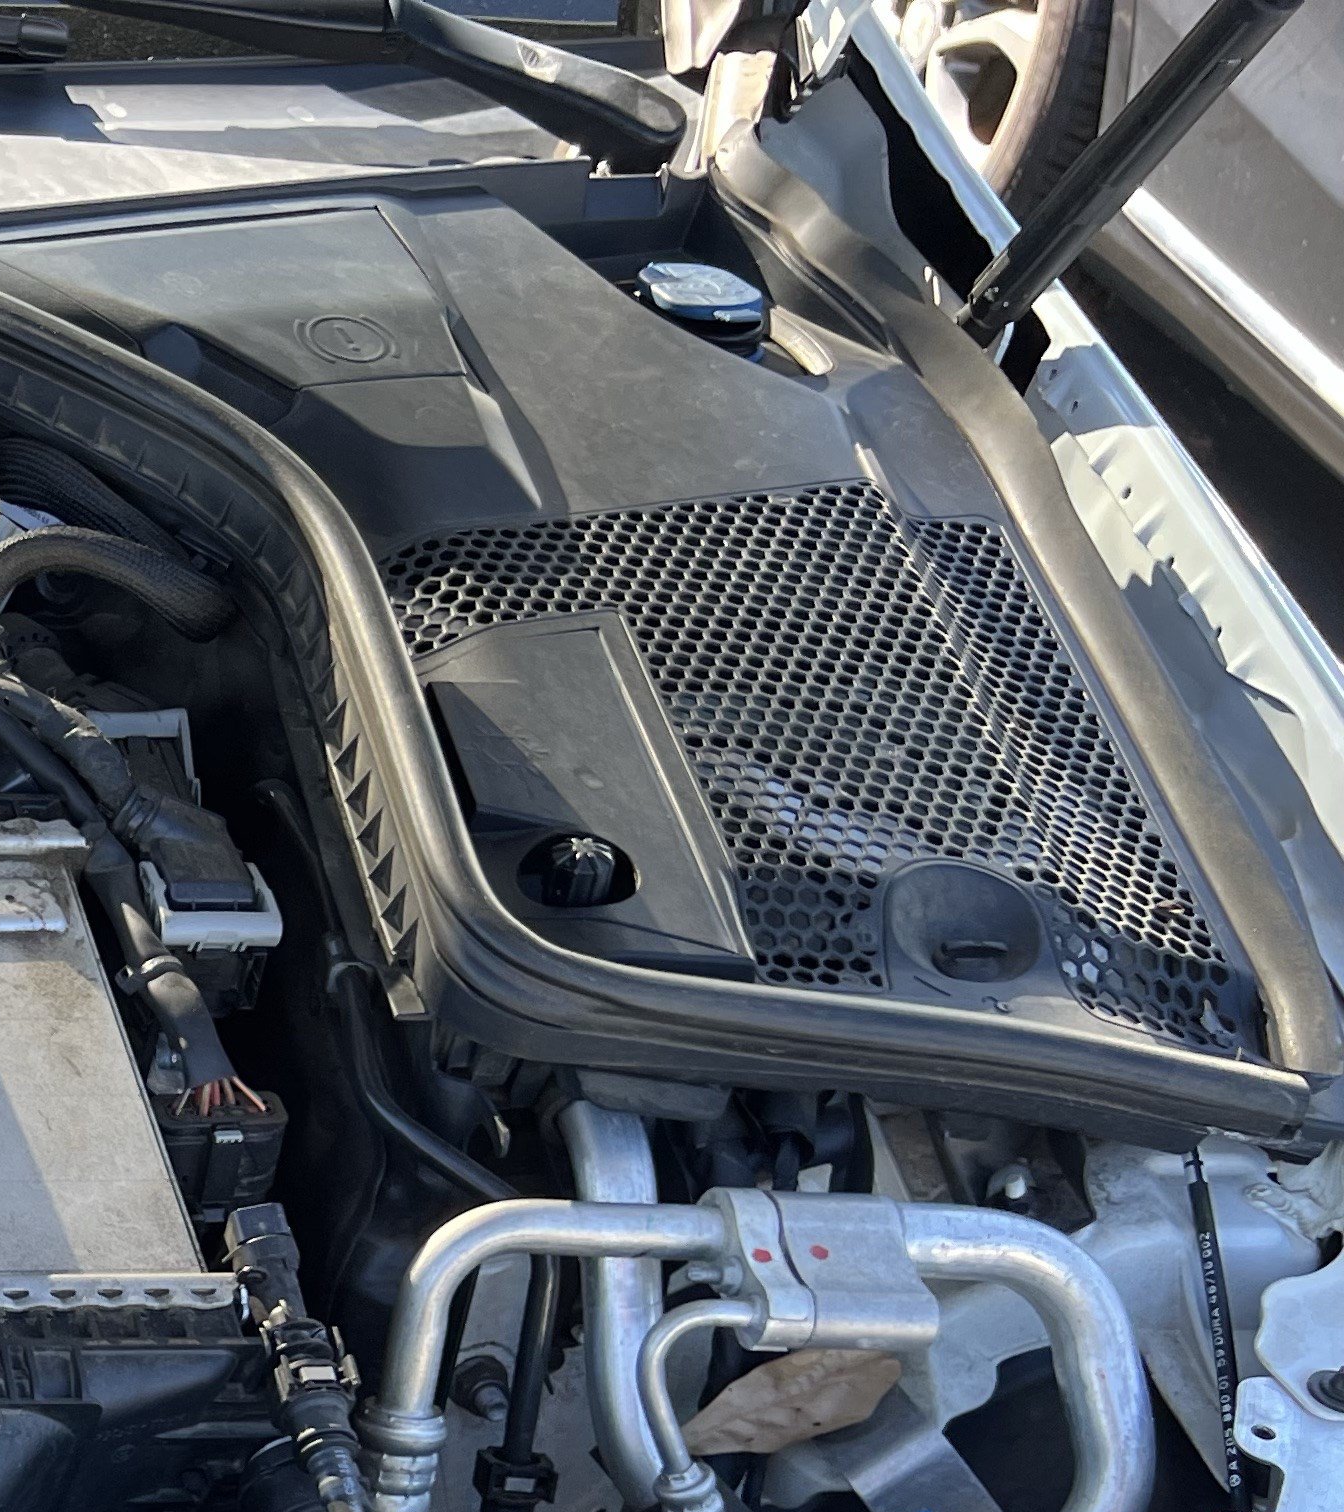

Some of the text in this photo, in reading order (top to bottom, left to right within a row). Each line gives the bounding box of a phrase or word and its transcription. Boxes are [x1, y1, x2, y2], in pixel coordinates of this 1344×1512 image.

[1211, 1307, 1224, 1346] DURA
[1217, 1375, 1229, 1390] 01
[1224, 1427, 1238, 1456] 205
[1228, 1460, 1238, 1470] A
